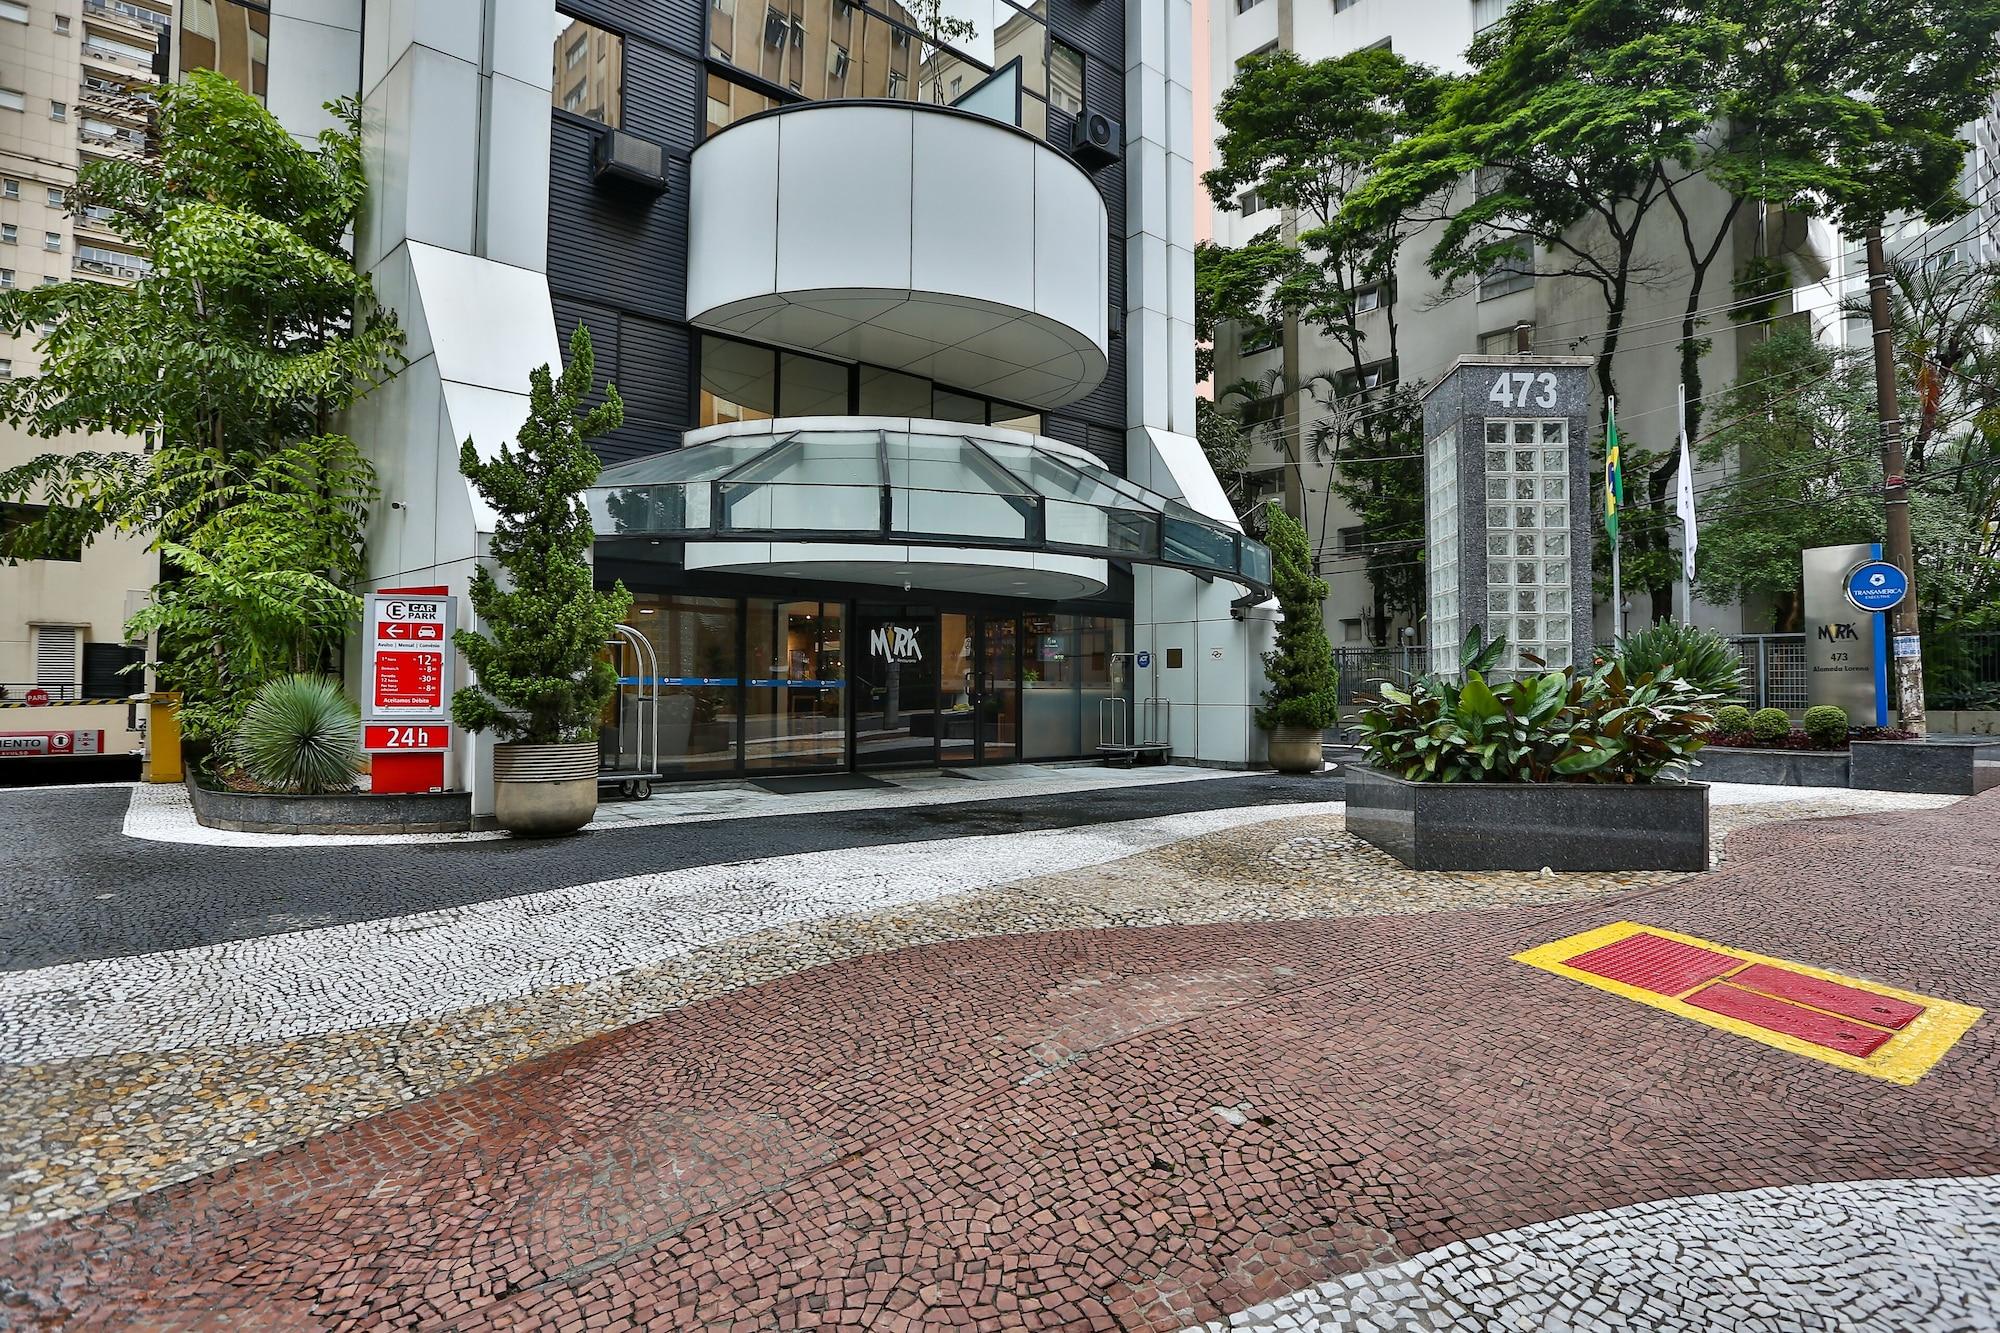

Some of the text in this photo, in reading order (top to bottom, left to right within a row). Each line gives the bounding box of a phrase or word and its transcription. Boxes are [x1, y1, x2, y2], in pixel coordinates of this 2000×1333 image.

[1489, 372, 1557, 408] 473
[1853, 588, 1903, 596] TRANSAMERICA
[411, 604, 434, 612] CAR
[408, 612, 436, 620] PARK
[417, 655, 432, 665] 12
[1830, 652, 1848, 661] 473
